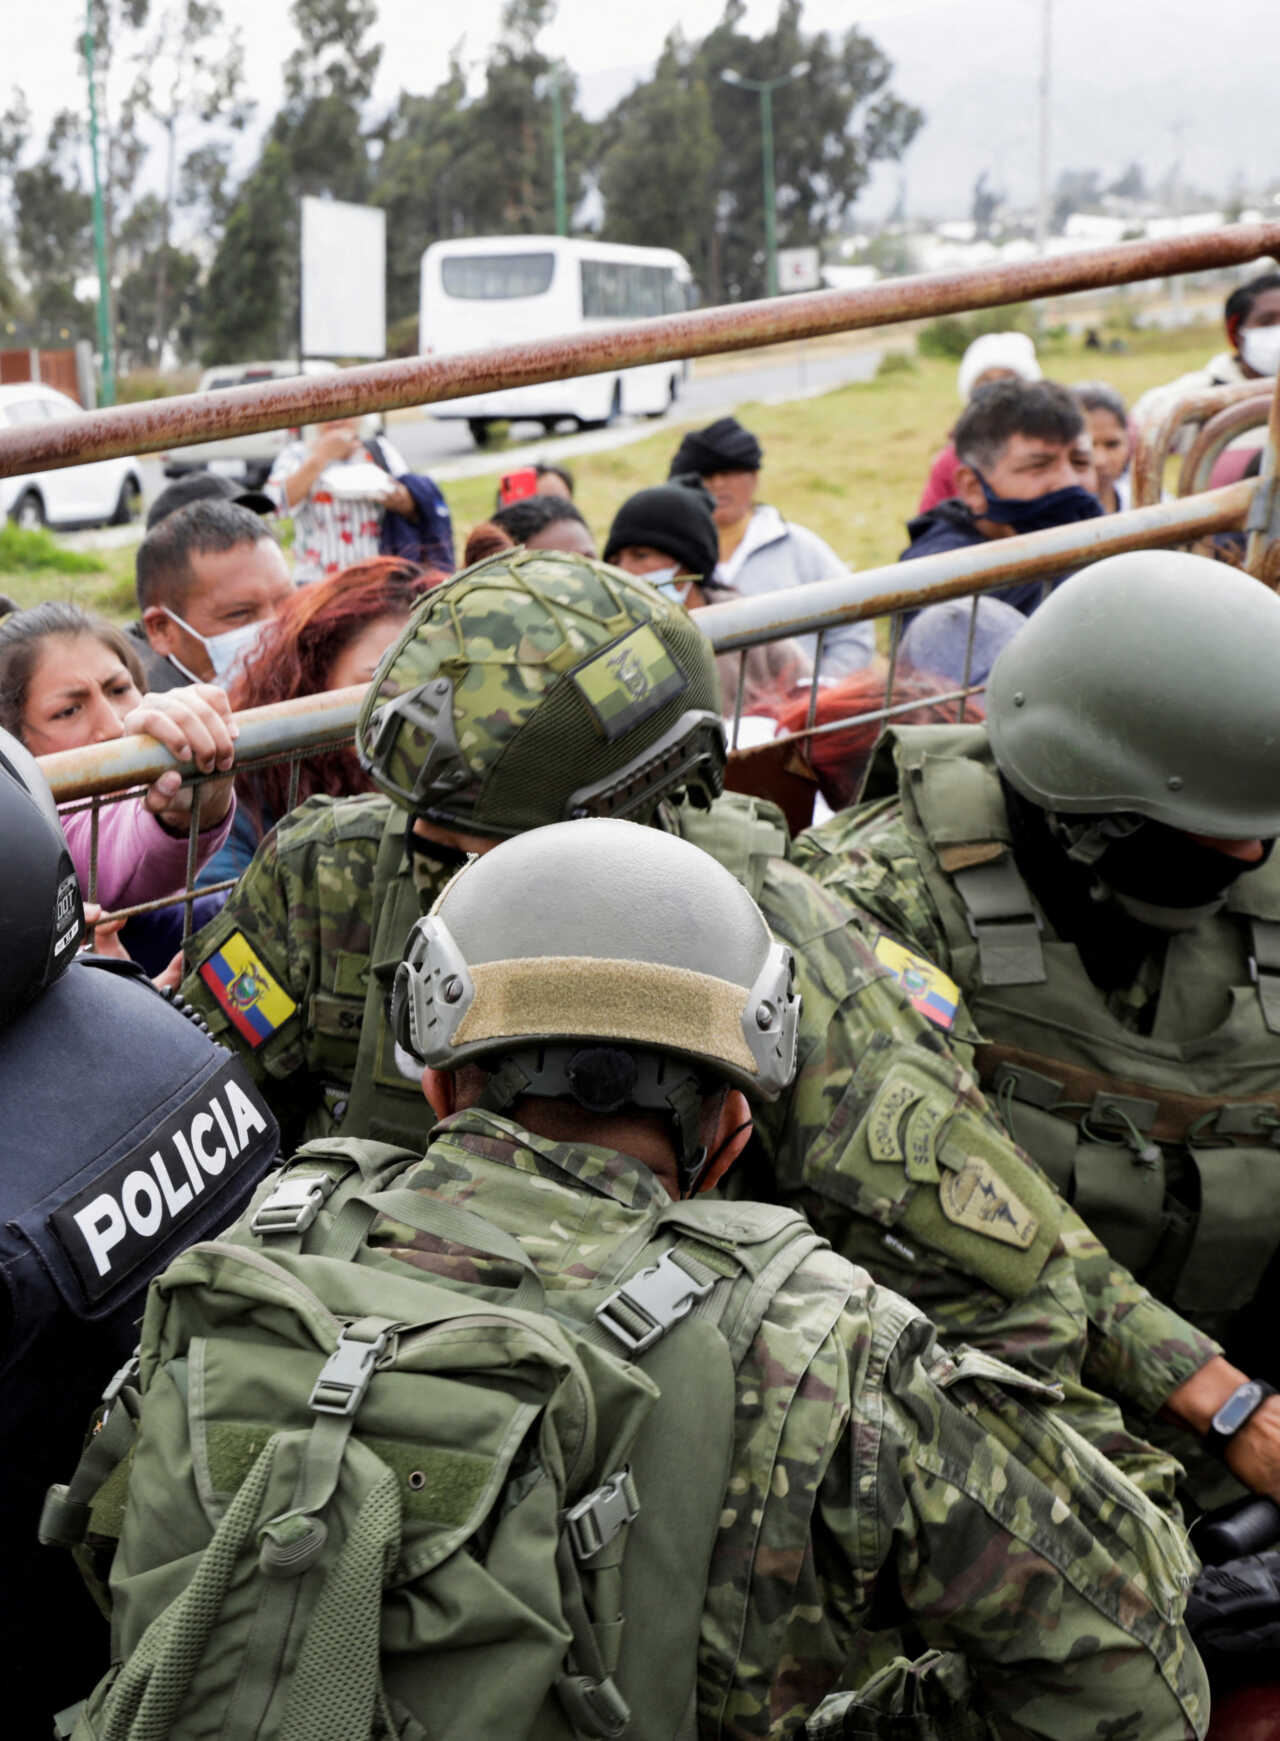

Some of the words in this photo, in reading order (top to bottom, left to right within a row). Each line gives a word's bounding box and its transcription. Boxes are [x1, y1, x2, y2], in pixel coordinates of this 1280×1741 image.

[876, 1086, 916, 1158] COMANDO
[913, 1107, 938, 1165] SELVA
[73, 1079, 267, 1277] POLICIA
